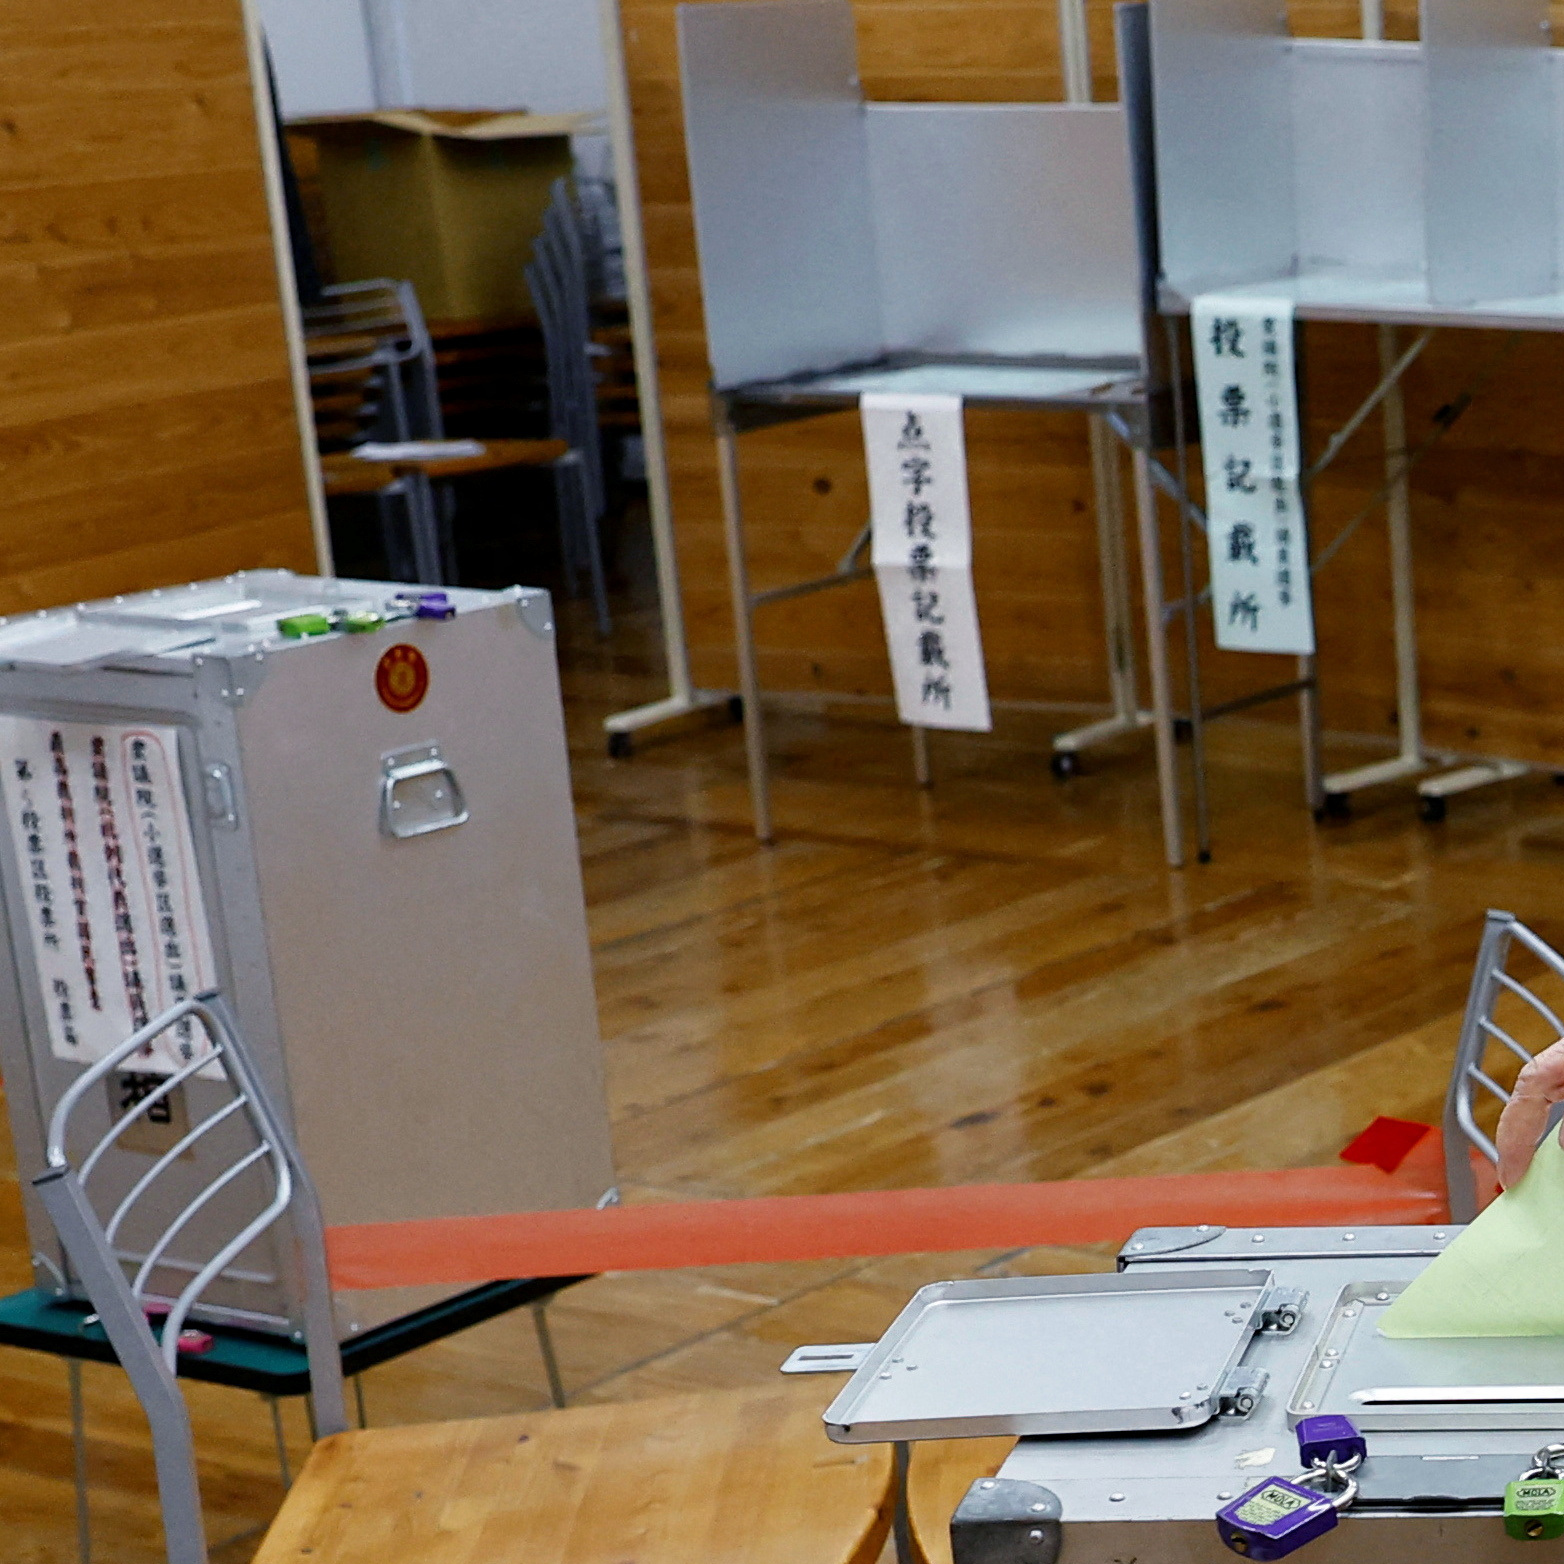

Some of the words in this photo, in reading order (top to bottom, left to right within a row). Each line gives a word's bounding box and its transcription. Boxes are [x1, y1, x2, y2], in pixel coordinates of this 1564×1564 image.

[896, 411, 953, 710] 点字投票記載所
[1208, 316, 1261, 633] 投票記載所
